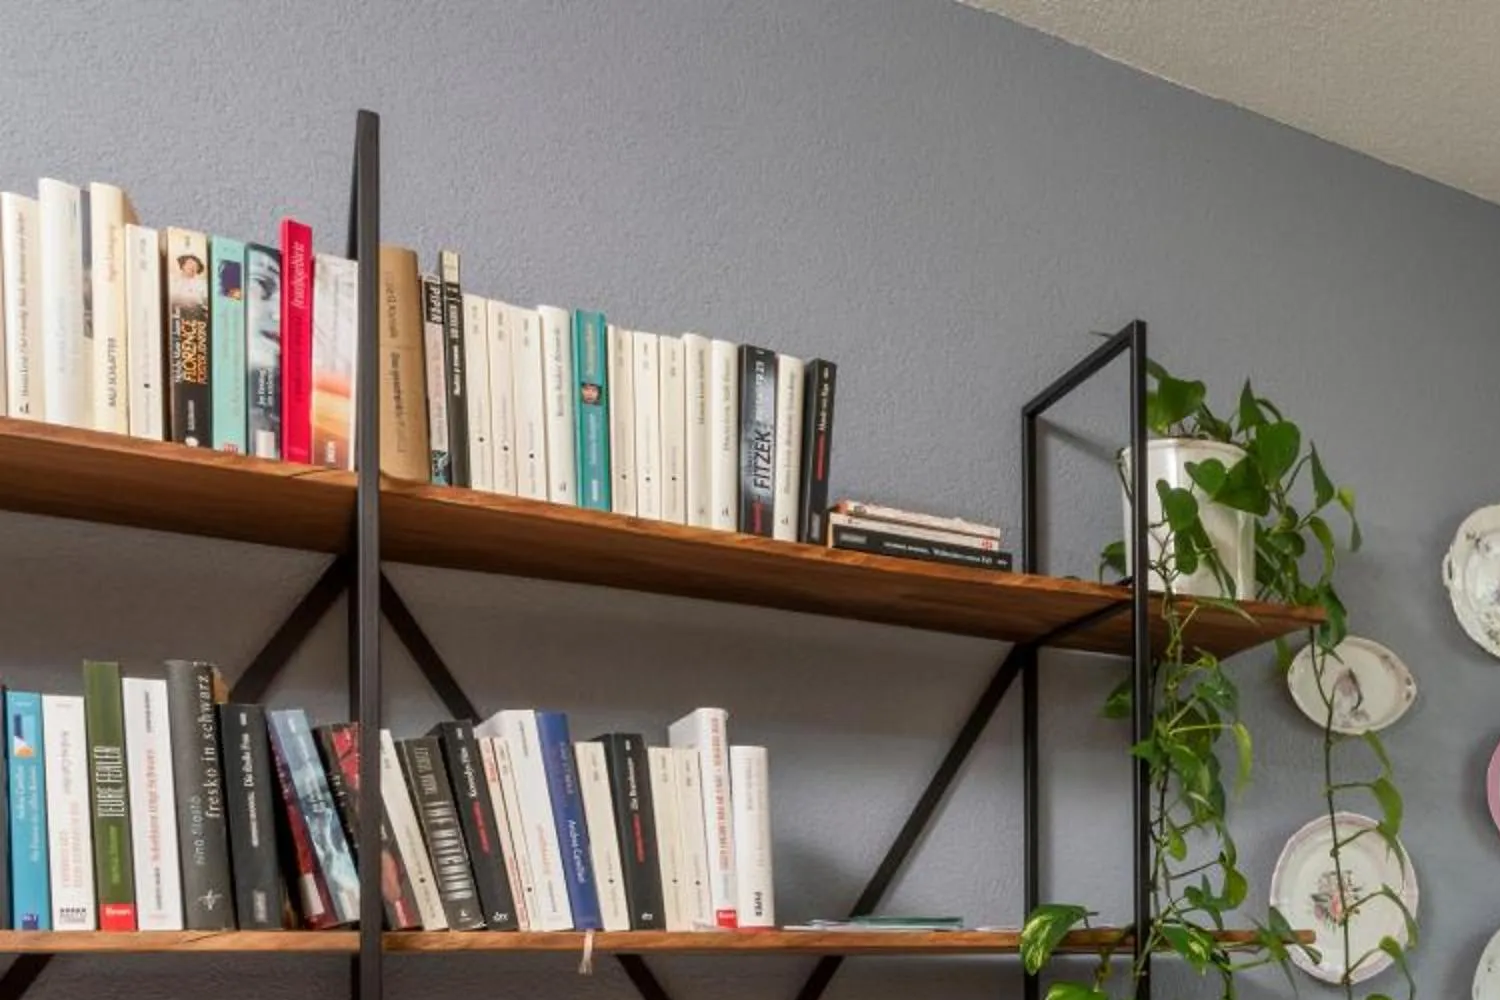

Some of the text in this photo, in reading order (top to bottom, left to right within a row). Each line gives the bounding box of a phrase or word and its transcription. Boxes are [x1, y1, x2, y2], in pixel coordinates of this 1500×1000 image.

[429, 285, 442, 323] PIPER
[181, 319, 197, 382] FLORENCE
[753, 428, 772, 490] FITZEK
[194, 674, 220, 818] fresko in schwarz
[93, 745, 126, 818] TEURE FEHLER
